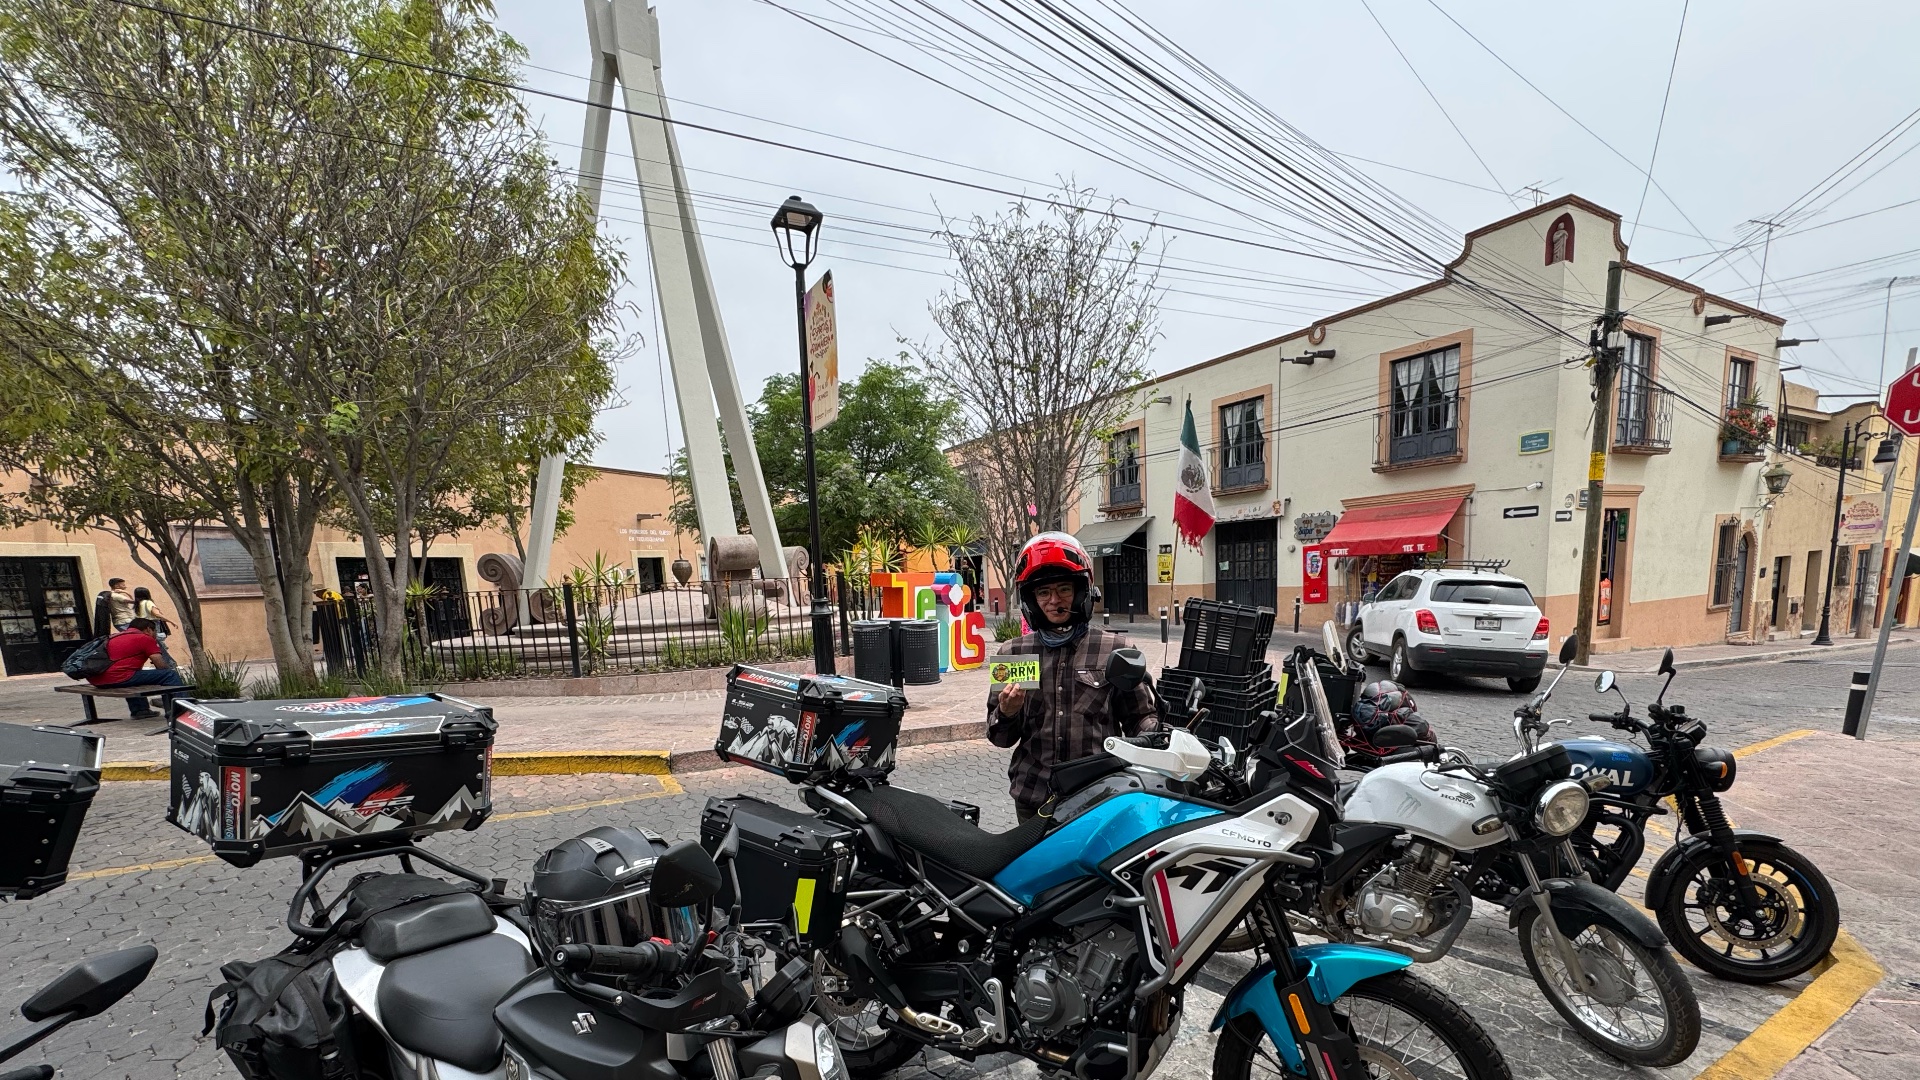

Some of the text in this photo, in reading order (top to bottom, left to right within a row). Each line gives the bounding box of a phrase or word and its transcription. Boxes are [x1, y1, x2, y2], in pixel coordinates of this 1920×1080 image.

[748, 672, 797, 690] DISCOVERY
[1010, 665, 1036, 678] RRM
[803, 714, 812, 741] MOTO
[230, 771, 242, 808] MOTO
[1440, 793, 1476, 809] HONDA
[225, 807, 235, 839] RACING
[1221, 828, 1272, 848] CFMOTO
